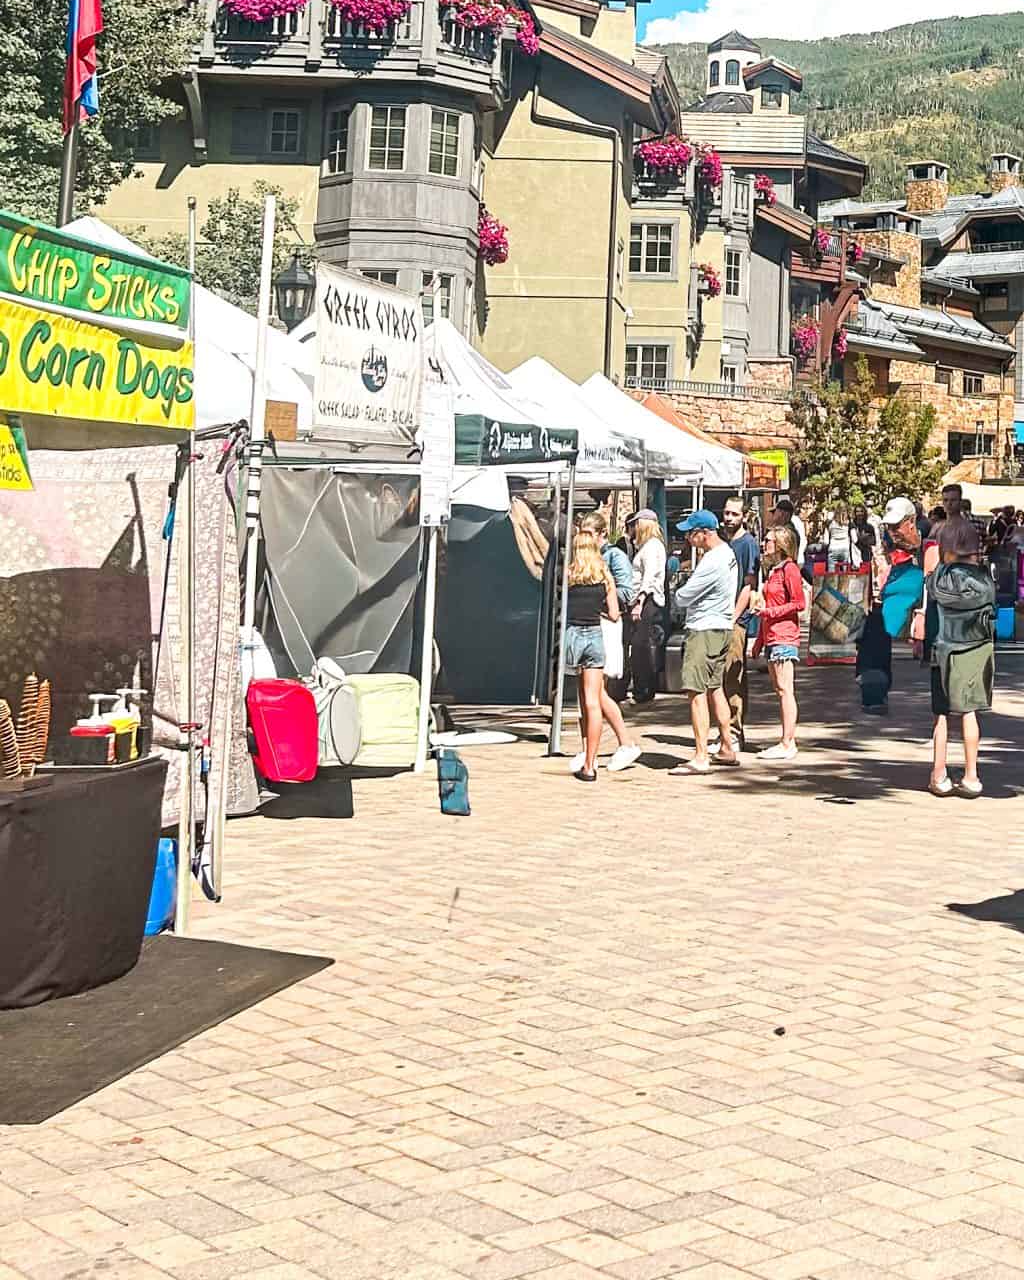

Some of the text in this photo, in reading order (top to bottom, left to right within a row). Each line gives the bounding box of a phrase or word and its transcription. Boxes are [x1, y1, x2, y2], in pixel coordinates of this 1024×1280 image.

[323, 283, 417, 343] GREEK GYROS
[20, 319, 105, 391] Corn
[116, 337, 194, 419] Dogs
